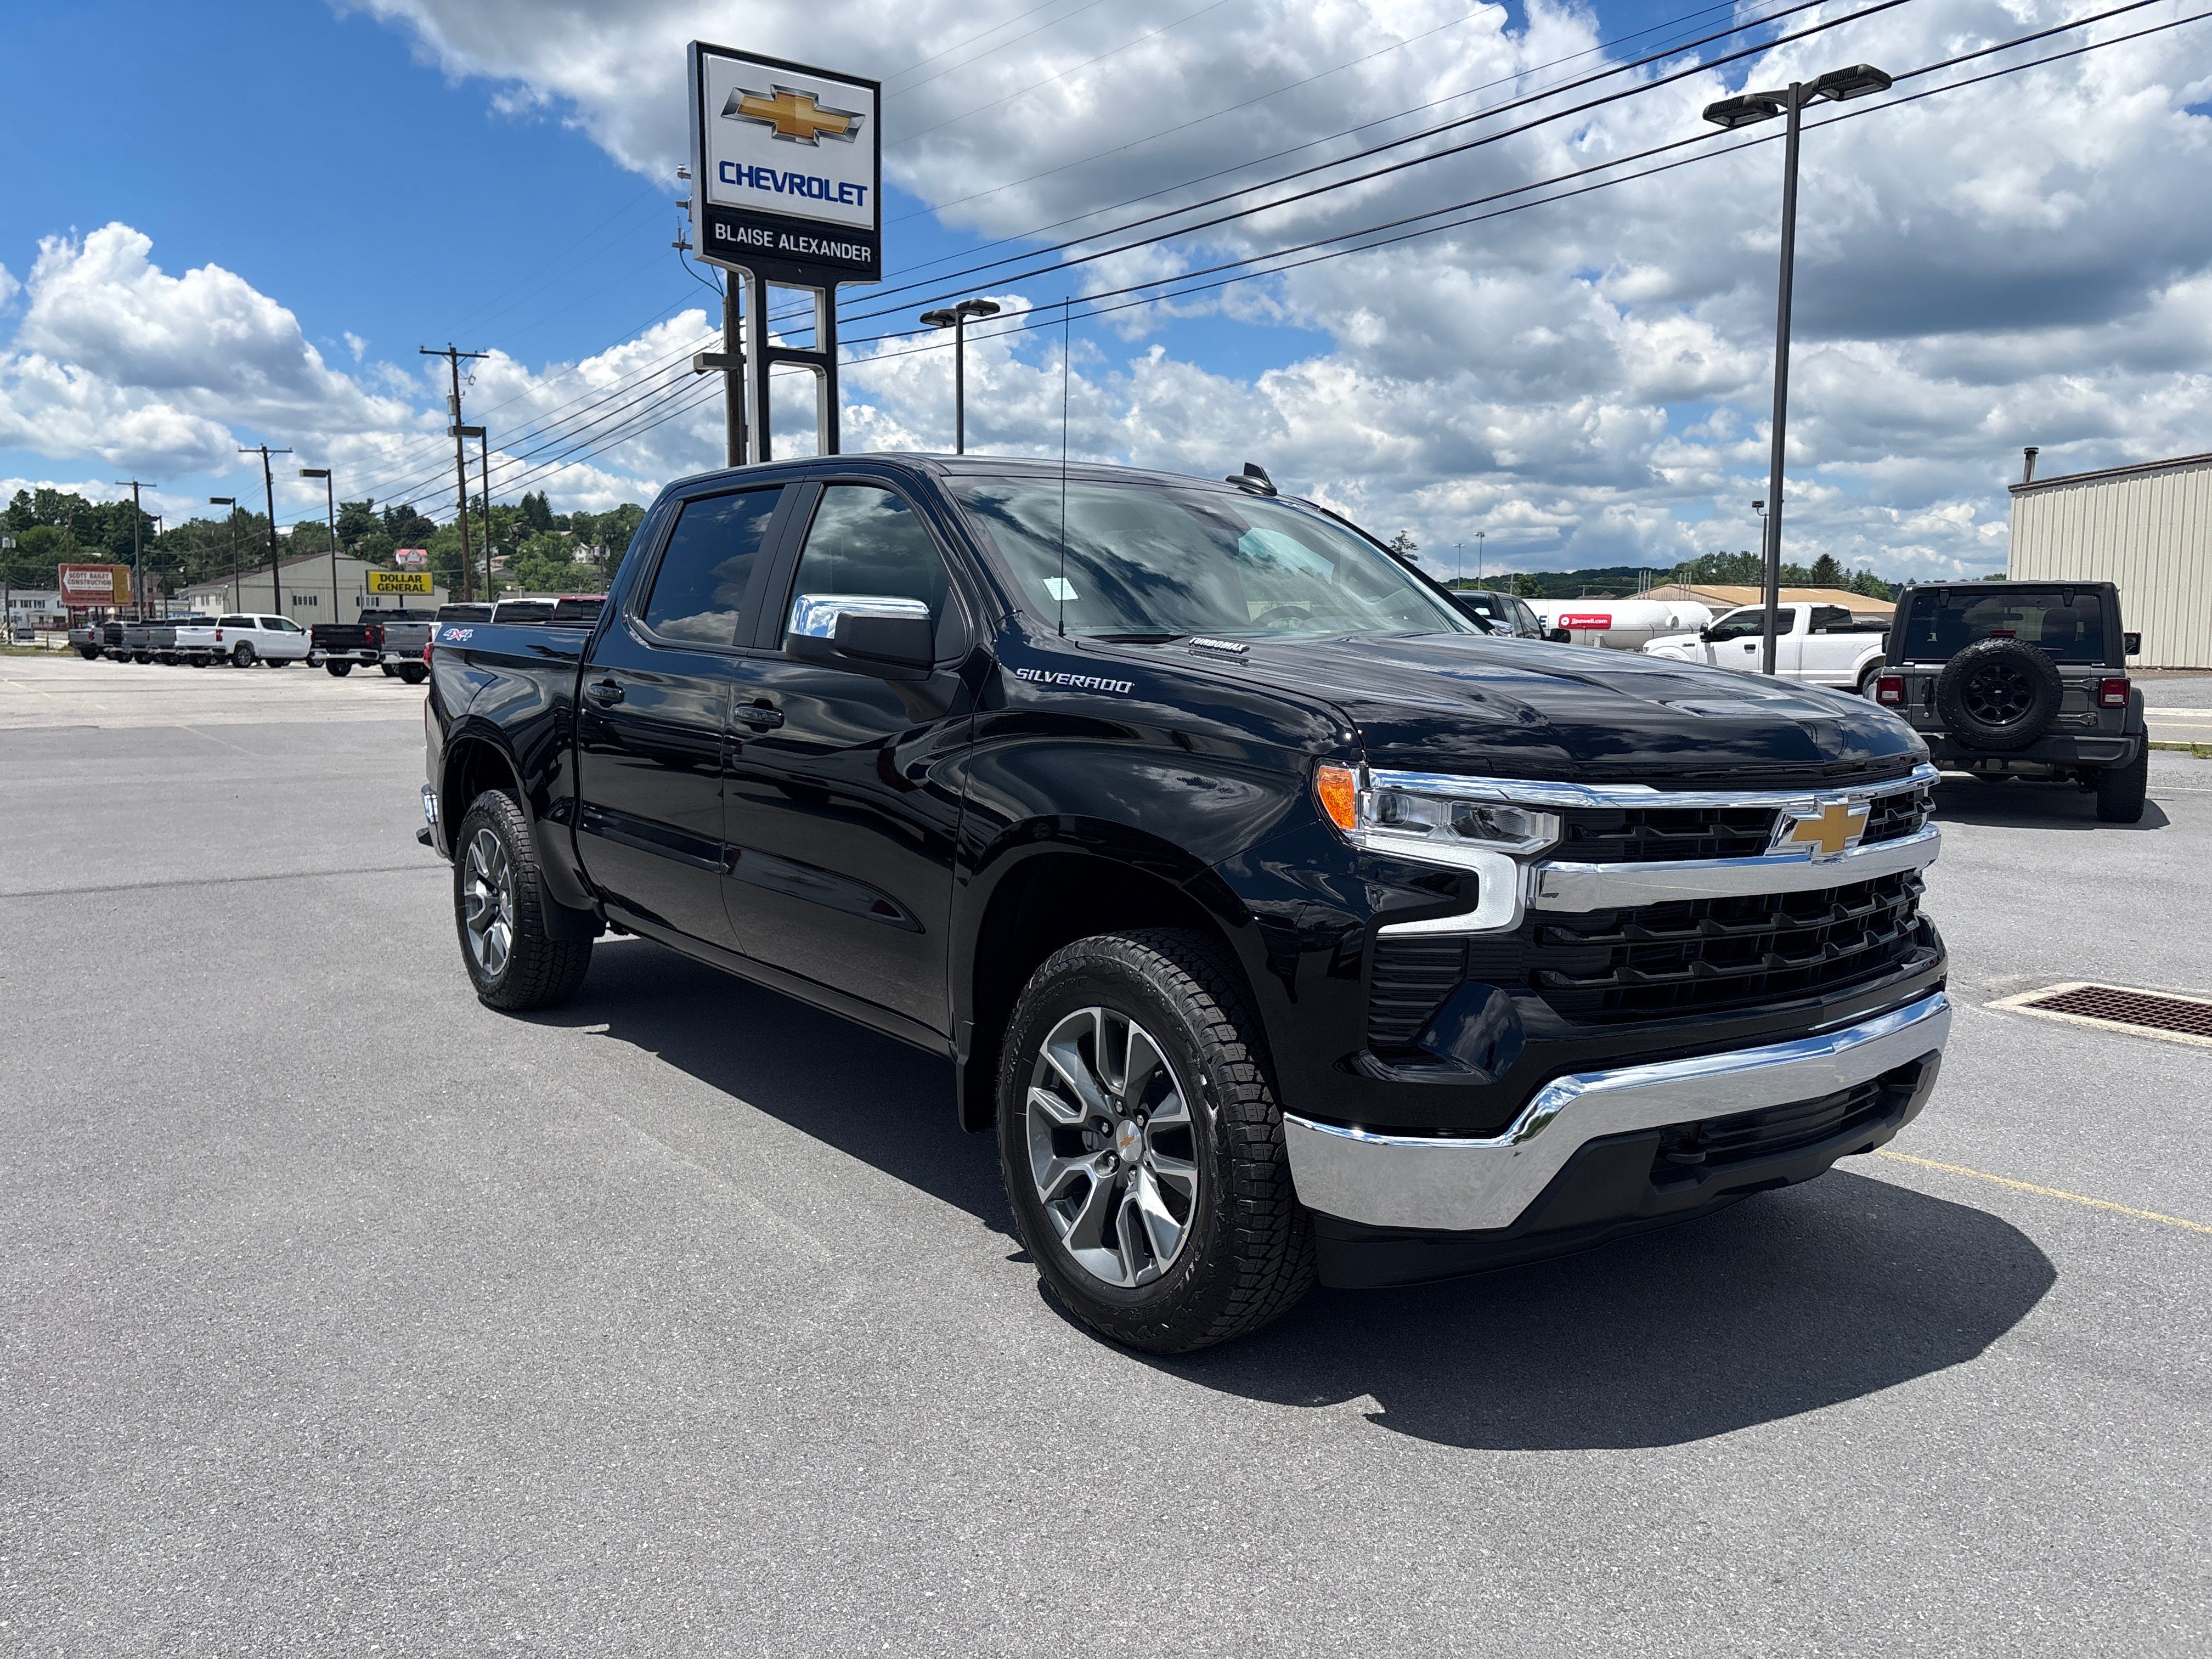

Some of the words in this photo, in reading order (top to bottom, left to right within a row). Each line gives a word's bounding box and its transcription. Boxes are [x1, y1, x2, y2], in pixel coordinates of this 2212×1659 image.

[719, 160, 868, 207] CHEVROLET
[715, 223, 774, 247] BLAISE
[778, 234, 871, 263] ALEXANDER
[377, 583, 426, 592] GENERAL
[379, 573, 422, 583] DOLLAR
[1188, 637, 1248, 652] TURBOMAX
[1015, 668, 1132, 694] SILVERADO
